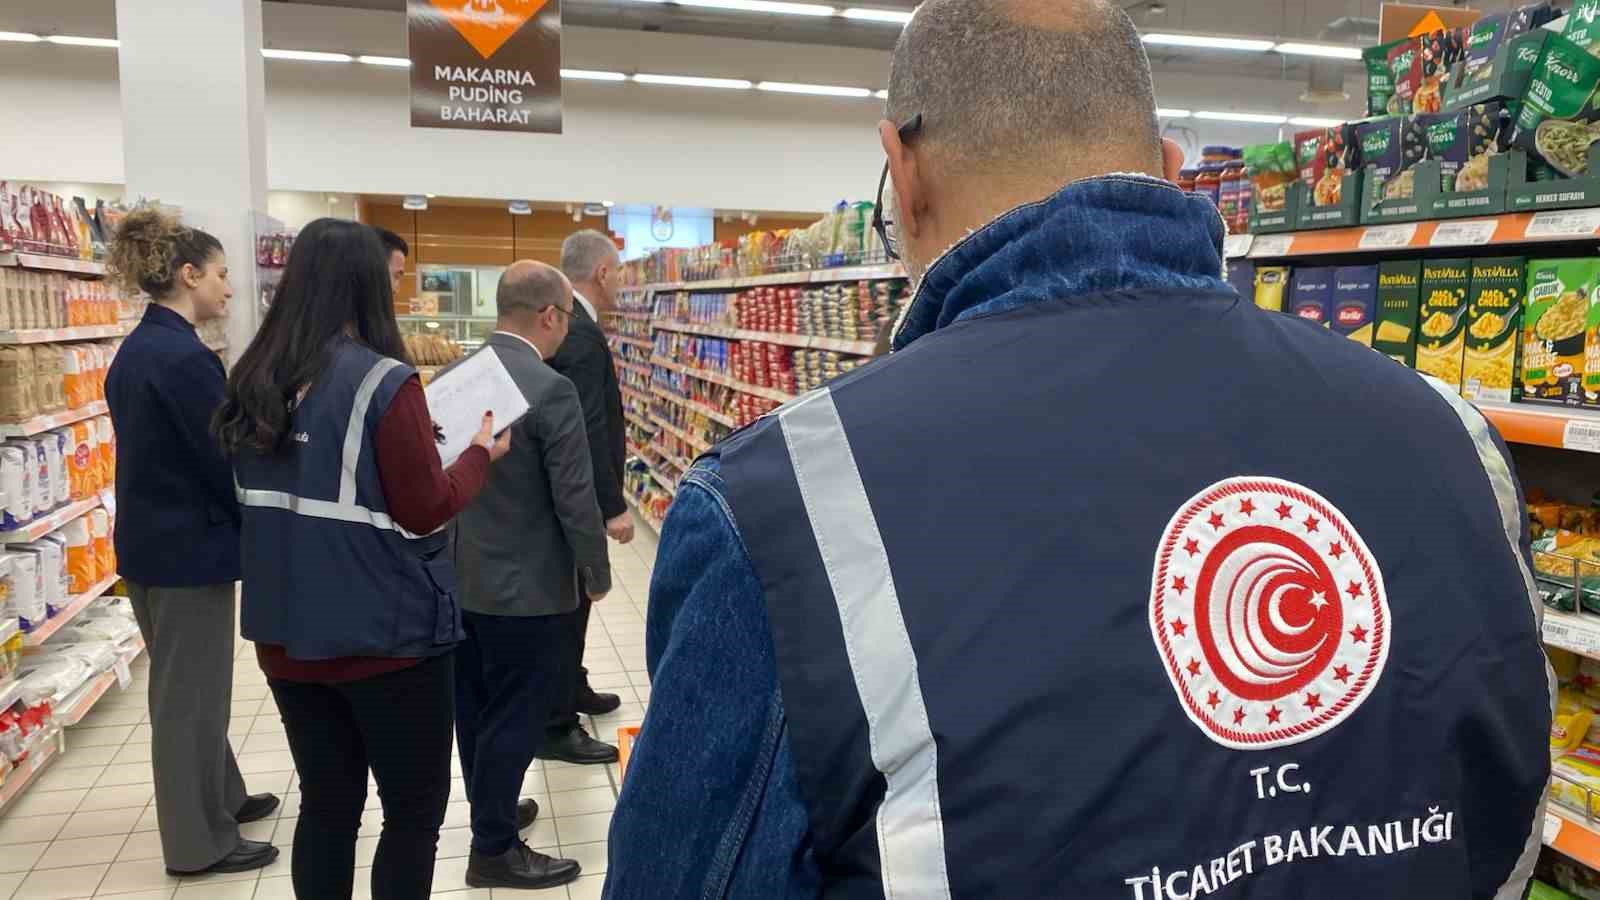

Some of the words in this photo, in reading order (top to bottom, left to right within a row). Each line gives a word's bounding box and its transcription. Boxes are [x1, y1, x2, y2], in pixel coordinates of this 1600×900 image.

[434, 65, 536, 86] MAKARNA
[1544, 51, 1579, 83] Knorr
[449, 85, 523, 104] PUDİNG
[1530, 79, 1553, 101] PESTO
[440, 105, 531, 124] BAHARAT
[1425, 131, 1454, 144] Knorr
[1423, 267, 1466, 279] PASTAVILLA
[1472, 265, 1518, 279] PASTAVILLA
[1478, 295, 1510, 307] CHEESE
[1250, 763, 1311, 799] T.C.
[1125, 840, 1257, 900] TİCARET
[1263, 805, 1454, 866] BAKANLIĞI
